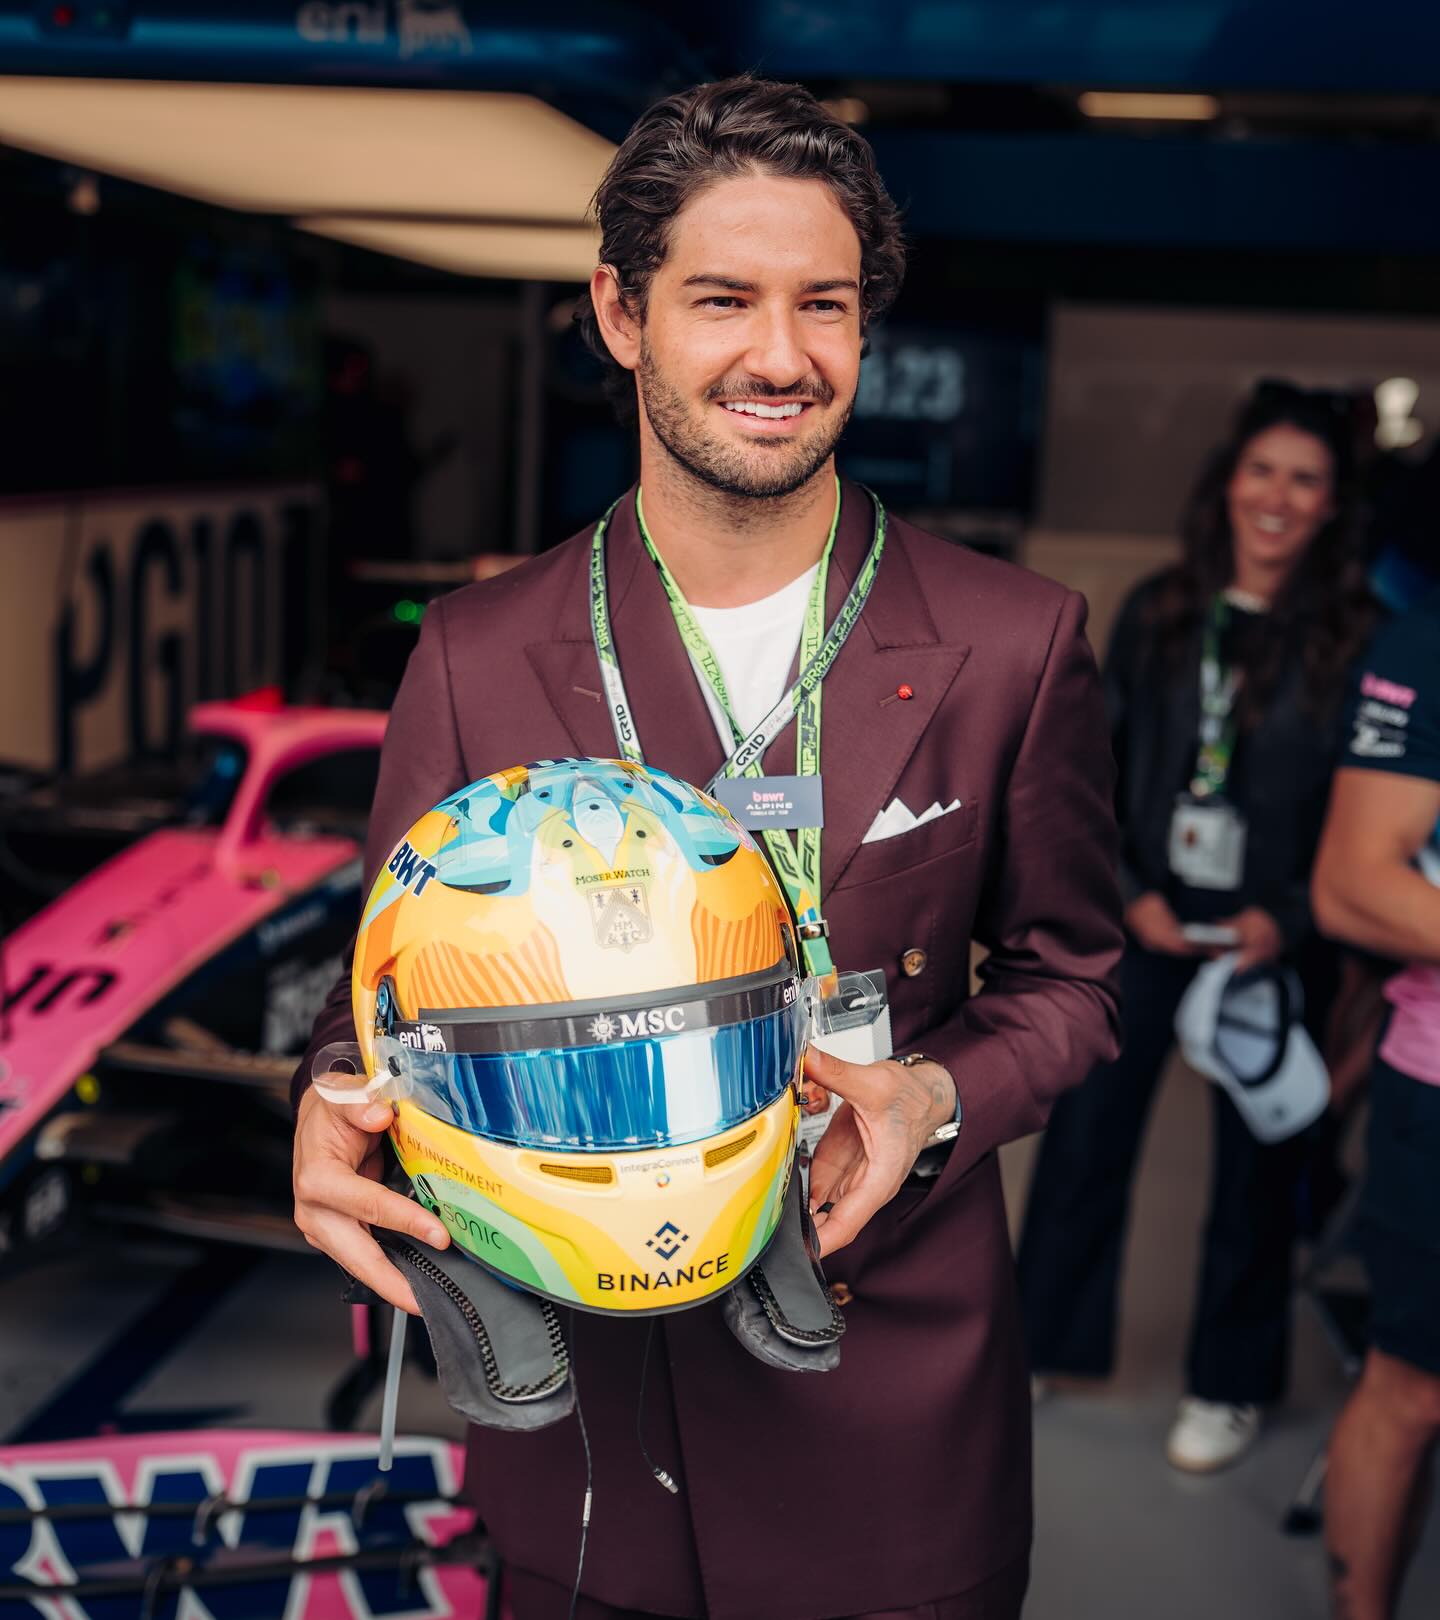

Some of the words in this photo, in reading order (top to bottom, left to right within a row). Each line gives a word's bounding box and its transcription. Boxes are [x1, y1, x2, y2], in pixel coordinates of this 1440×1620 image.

[800, 639, 840, 691] BRAZIL
[615, 703, 633, 742] GRID
[735, 734, 766, 766] GRID
[746, 802, 793, 811] ALPINE
[388, 840, 438, 895] BWT
[612, 868, 650, 880] WATCH
[399, 1026, 422, 1049] eni
[618, 1007, 686, 1038] MSC
[425, 1146, 504, 1198] INVESTMENT
[620, 1155, 700, 1175] IntegraConnect
[597, 1252, 730, 1292] BINANCE
